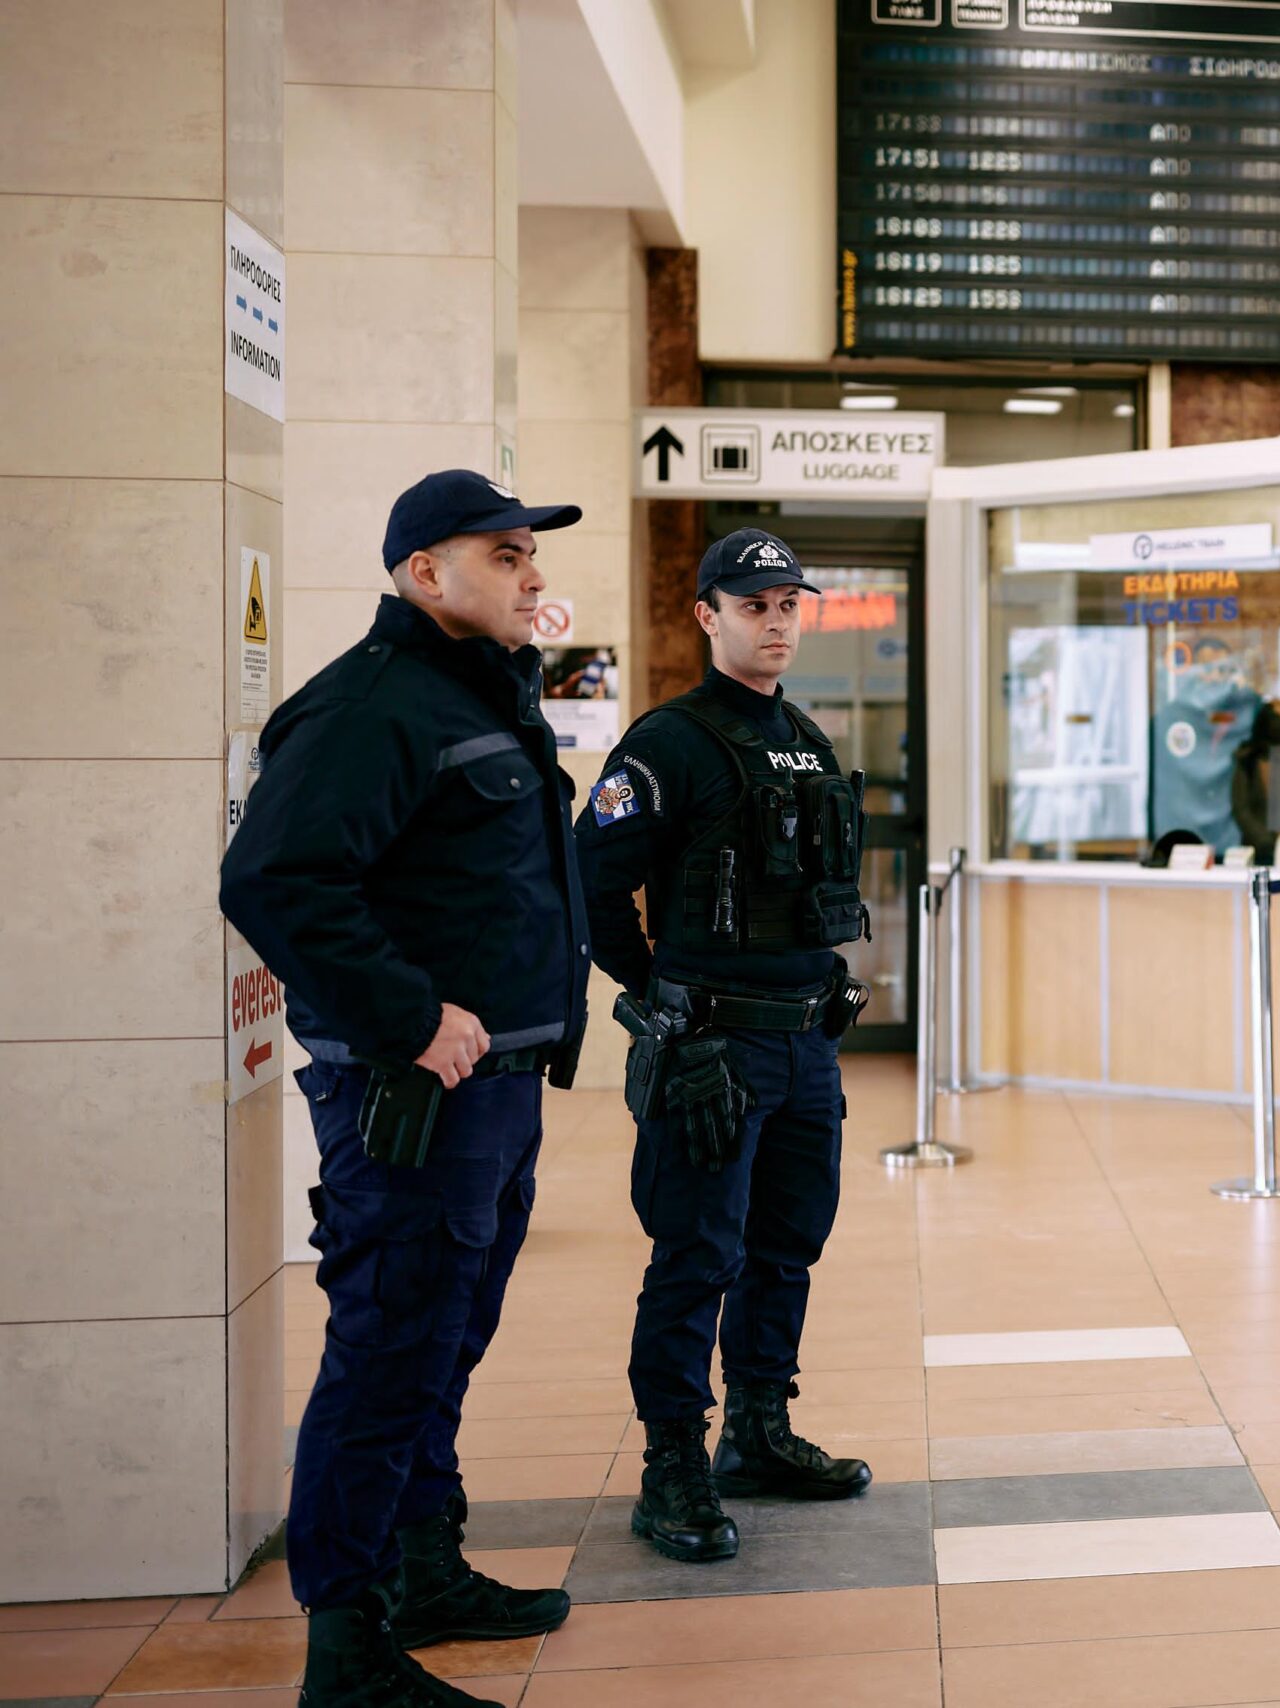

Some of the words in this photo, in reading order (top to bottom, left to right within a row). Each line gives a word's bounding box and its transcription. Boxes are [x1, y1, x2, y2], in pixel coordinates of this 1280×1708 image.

[230, 245, 281, 302] ΠΛΗΡΟΦΟΡΙΕΣ
[230, 329, 281, 382] INFORMATION
[771, 430, 933, 455] ΑΠΟΣΚΕΥΕΣ
[803, 463, 899, 481] LUGGAGE
[753, 559, 788, 568] POLICE
[1123, 569, 1240, 596] ΕΚΔΟΤΗΡΙΑ
[1121, 596, 1240, 625] TICKETS
[766, 751, 824, 772] POLICE
